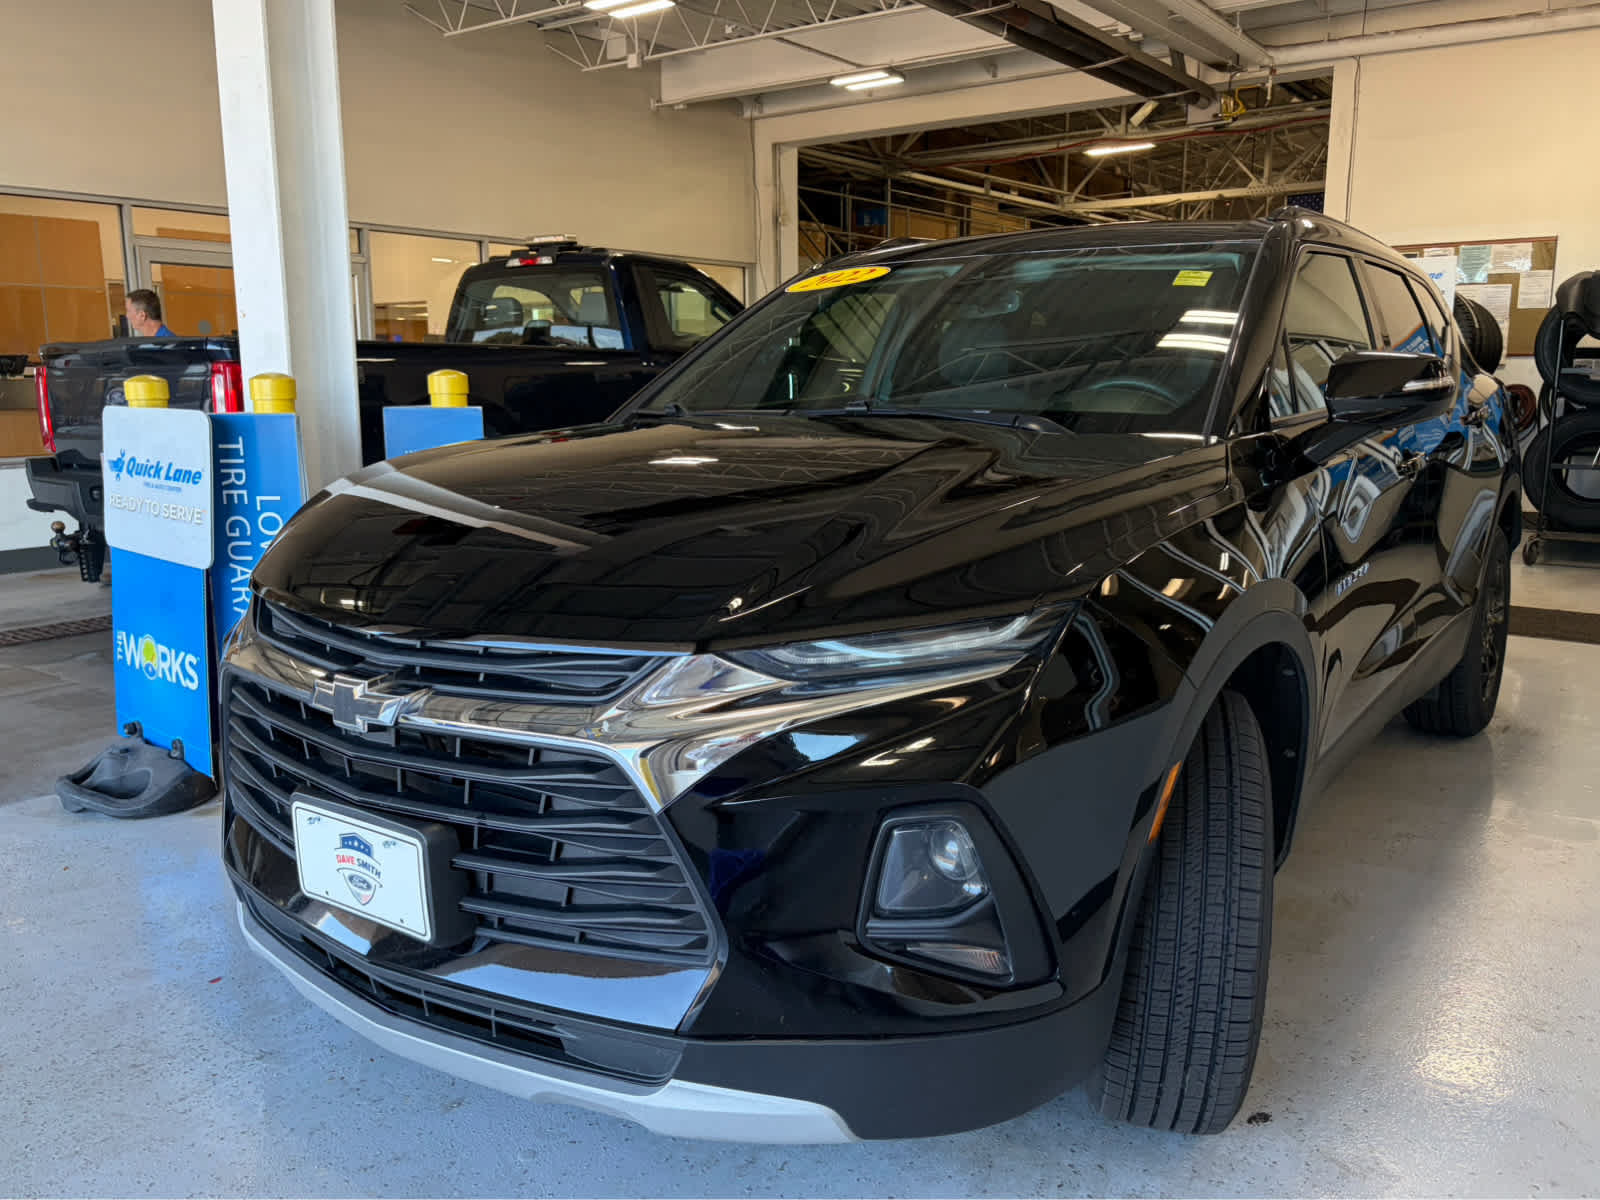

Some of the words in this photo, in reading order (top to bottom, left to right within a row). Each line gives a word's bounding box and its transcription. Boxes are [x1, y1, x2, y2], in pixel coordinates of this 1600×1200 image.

[126, 456, 163, 478] Quick
[164, 462, 202, 485] Lane
[218, 436, 249, 505] TIRE
[109, 495, 143, 513] READY
[144, 498, 160, 517] TO
[162, 503, 204, 525] SERVE
[122, 631, 199, 691] WORKS
[336, 854, 356, 865] DAVE
[357, 858, 381, 879] SMITH
